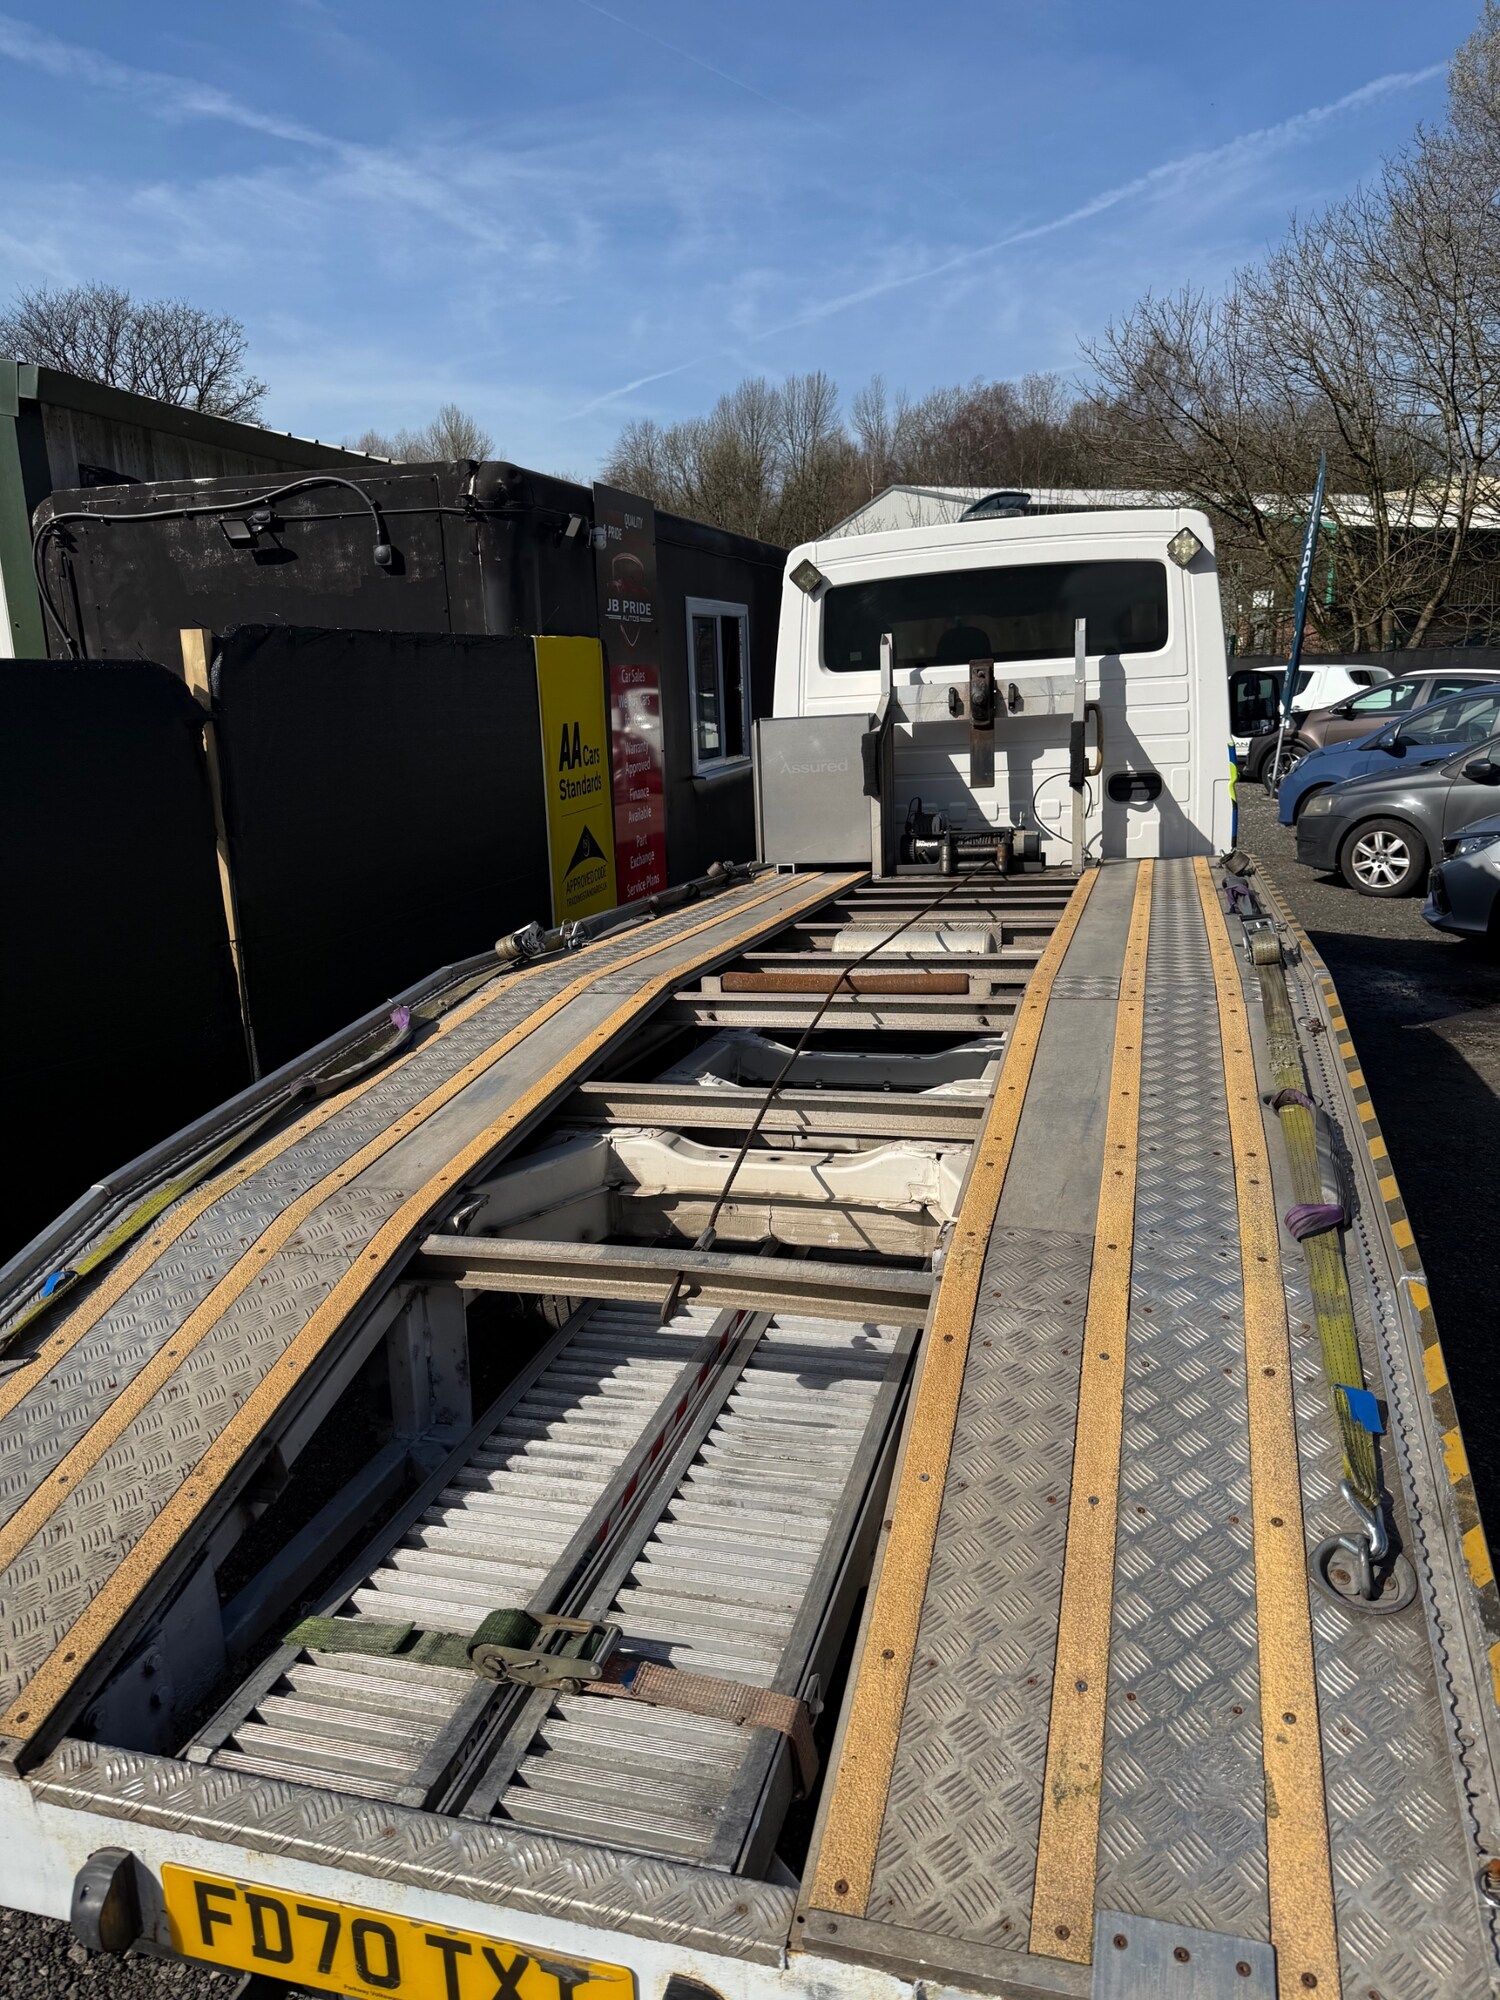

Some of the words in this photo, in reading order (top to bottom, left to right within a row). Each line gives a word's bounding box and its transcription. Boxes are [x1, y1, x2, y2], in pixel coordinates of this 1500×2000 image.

[624, 513, 644, 530] QUALITY
[607, 526, 623, 541] PRIDE
[607, 598, 620, 613] JB
[622, 600, 652, 616] PRIDE
[621, 669, 631, 683] Car
[631, 669, 646, 683] Sales
[558, 721, 582, 772] AA
[582, 745, 600, 766] Cars
[624, 741, 649, 756] Warranty
[625, 757, 651, 778] Approved
[780, 759, 848, 774] Assured
[559, 771, 602, 801] Standards
[629, 786, 650, 801] Finance
[628, 805, 652, 824] Available
[636, 834, 648, 848] Part
[630, 850, 655, 870] Exchange
[566, 870, 594, 894] APPROVED
[594, 864, 607, 882] CODE
[626, 880, 646, 898] Service
[646, 873, 660, 888] Plans
[193, 1880, 401, 1990] FD70
